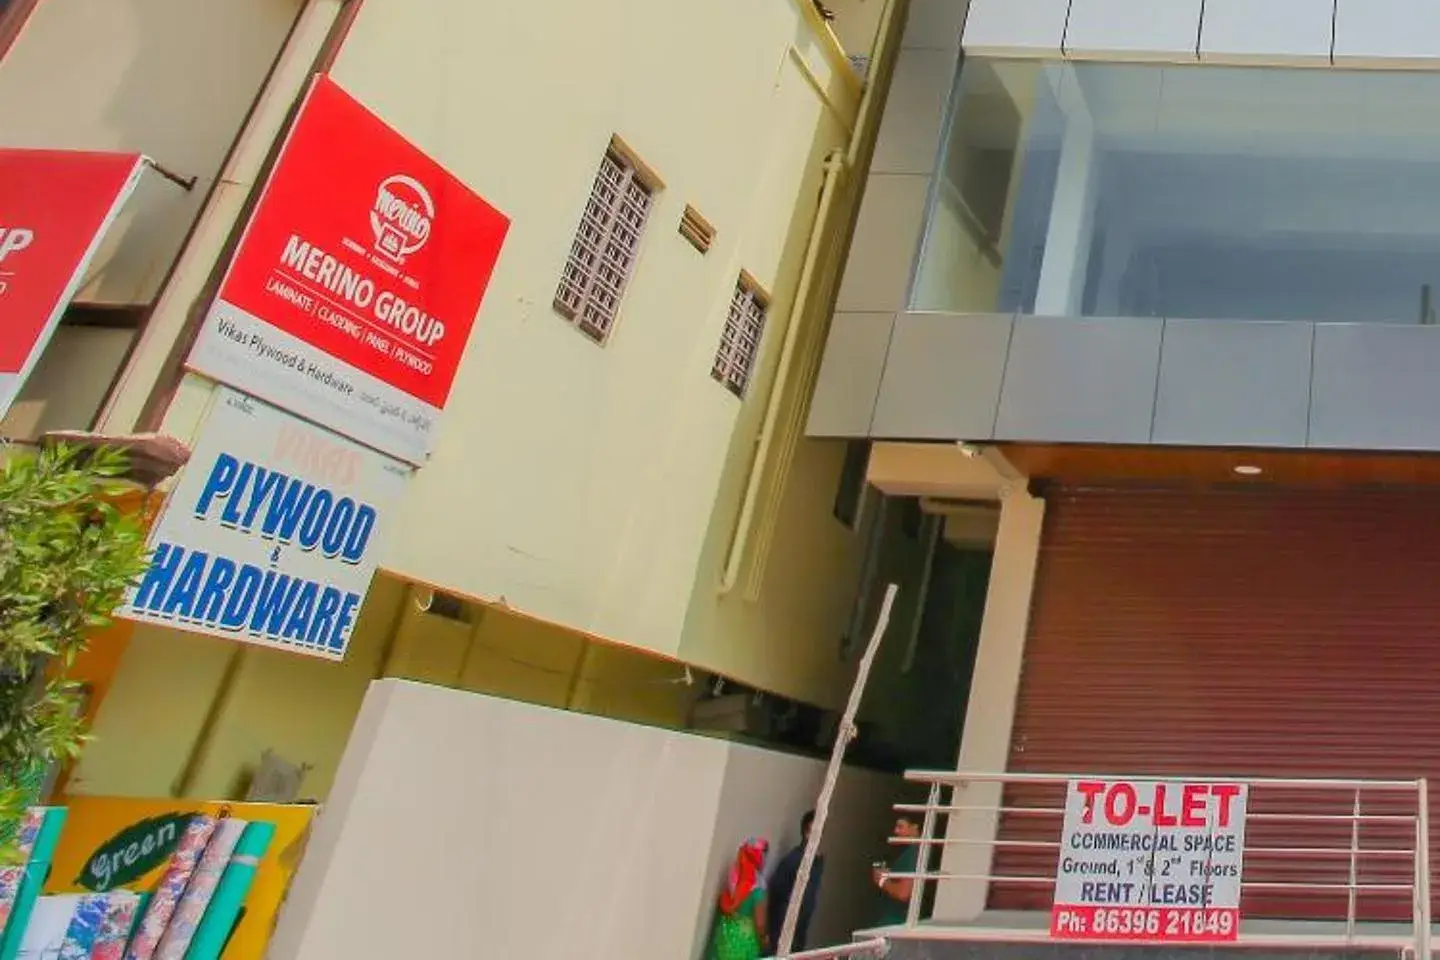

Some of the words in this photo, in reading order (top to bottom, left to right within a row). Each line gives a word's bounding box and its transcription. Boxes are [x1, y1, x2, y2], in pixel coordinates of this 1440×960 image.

[266, 278, 315, 312] LAMINATE
[280, 234, 376, 309] MERINO
[374, 290, 446, 347] GROUP
[215, 315, 248, 346] Vikas
[249, 330, 298, 369] Plywood
[297, 357, 307, 374] &
[306, 363, 356, 396] Hardware
[194, 452, 377, 565] PLYWOOD
[269, 544, 283, 564] &
[131, 542, 362, 655] HARDWARE
[1077, 783, 1240, 828] TO-LET
[1070, 832, 1177, 852] COMMERCIAL
[1184, 834, 1236, 853] SPACE
[1062, 857, 1121, 878] Ground,
[1144, 859, 1156, 877] &
[1160, 855, 1182, 877] 2nd
[1189, 859, 1238, 878] Floors
[1081, 882, 1135, 903] RENT
[1151, 883, 1214, 906] LEASE
[1056, 912, 1087, 933] Ph:
[1092, 909, 1160, 934] 86396
[1164, 911, 1234, 936] 21849
